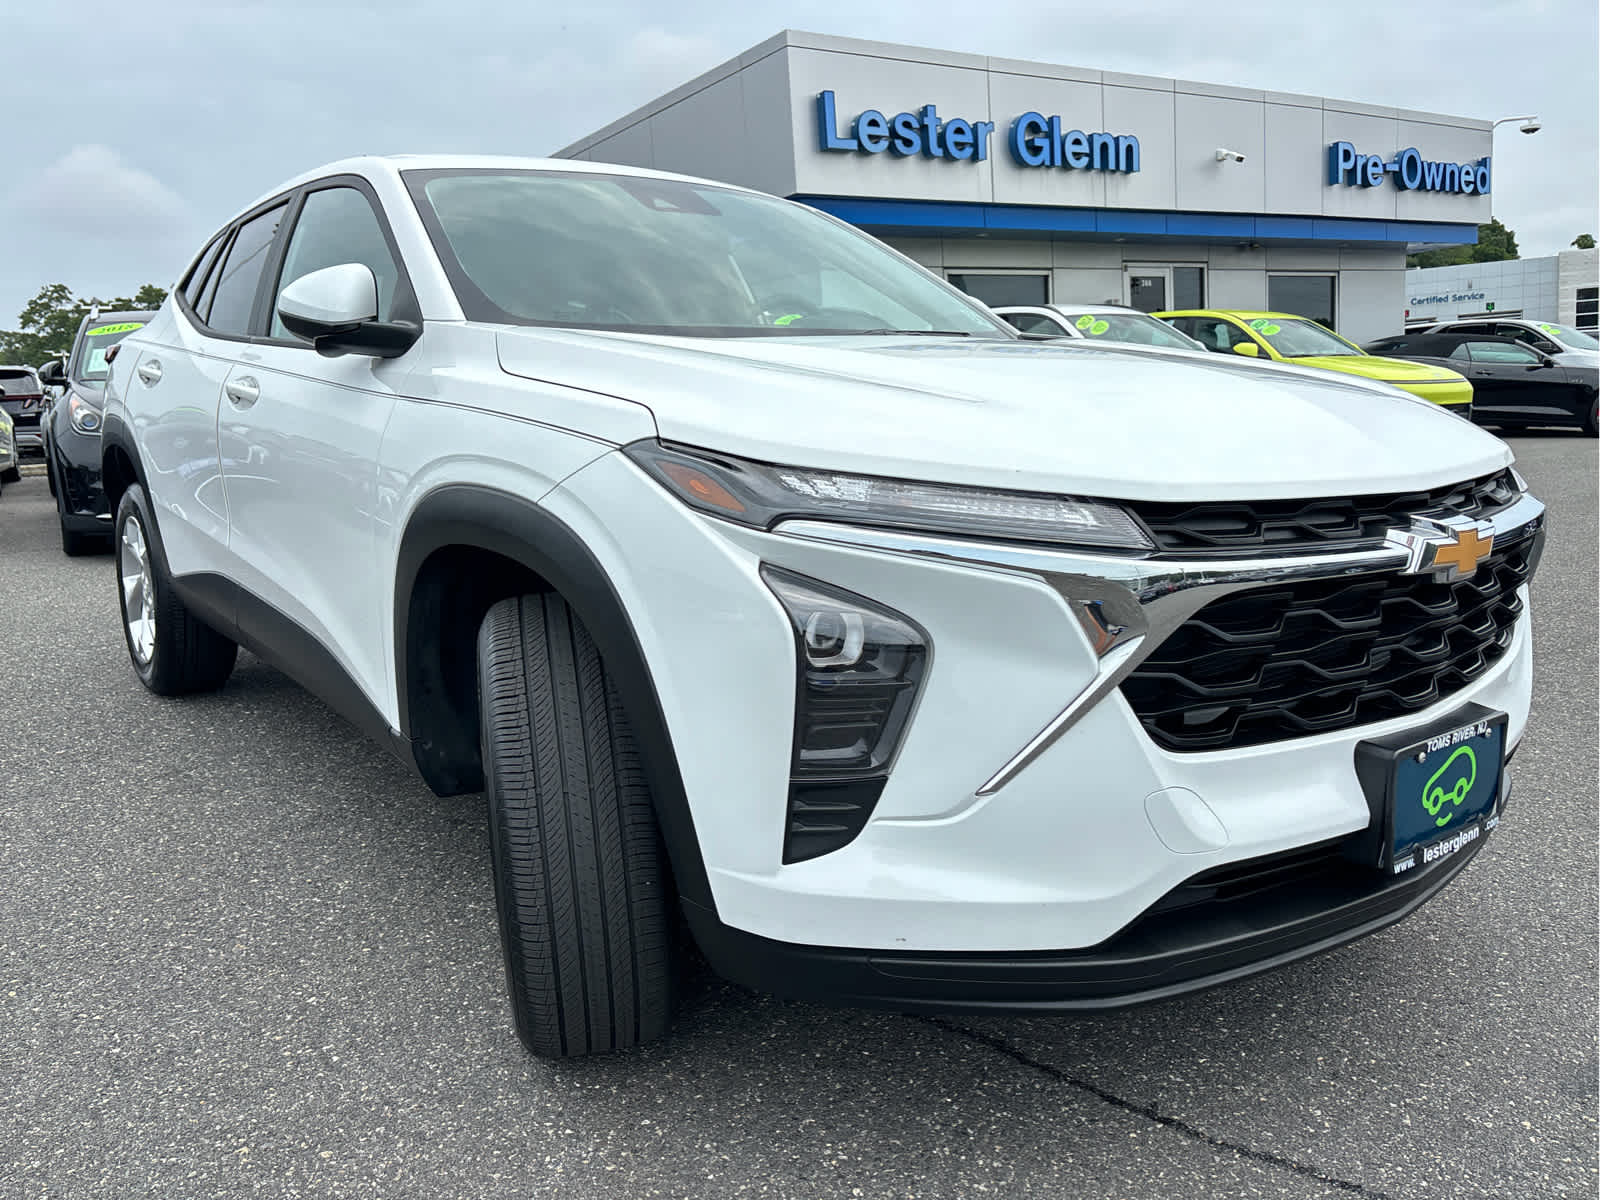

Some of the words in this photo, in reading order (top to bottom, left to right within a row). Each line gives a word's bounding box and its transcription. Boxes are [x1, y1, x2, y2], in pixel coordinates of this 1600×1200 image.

[816, 89, 995, 162] Lester
[1009, 111, 1141, 174] Glenn
[1328, 140, 1491, 195] Pre-Owned
[1410, 295, 1449, 306] Certified
[1452, 292, 1485, 302] Service
[1427, 735, 1451, 753] TOMS
[1477, 720, 1488, 735] NJ
[1393, 857, 1416, 874] www.
[1423, 826, 1480, 864] lesterglenn
